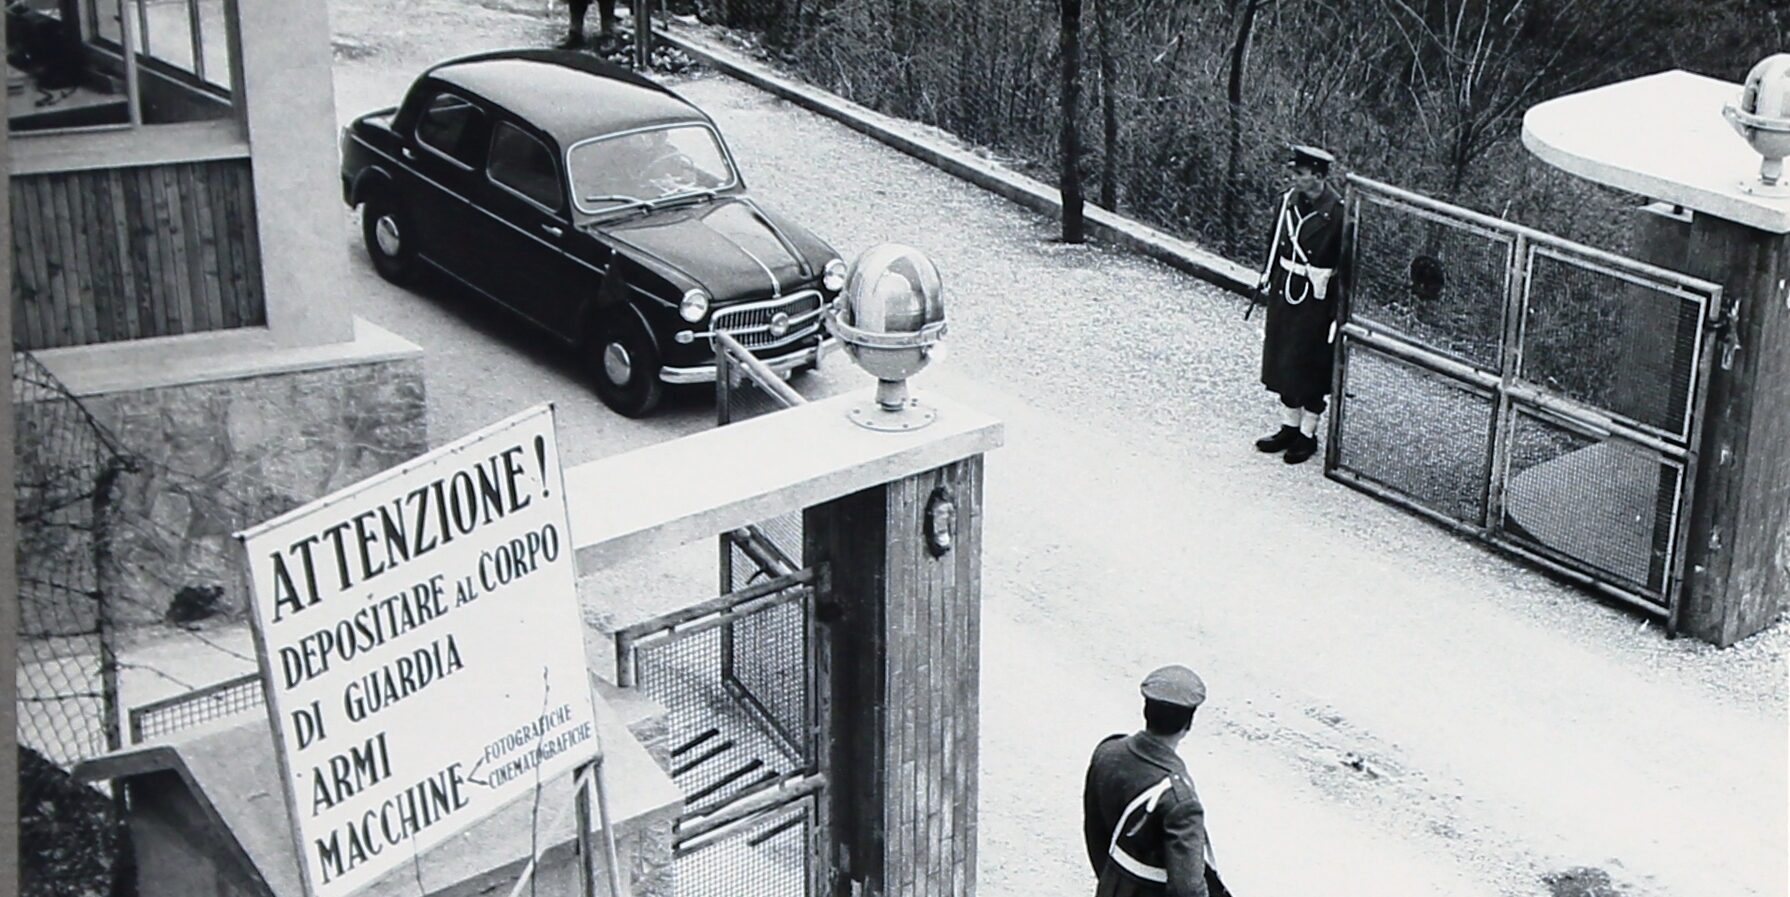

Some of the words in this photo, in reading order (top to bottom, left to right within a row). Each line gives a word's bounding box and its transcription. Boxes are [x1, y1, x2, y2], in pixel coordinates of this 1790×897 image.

[279, 574, 448, 690] DEPOSITARE
[455, 576, 478, 608] AL
[478, 524, 559, 592] CORPO
[291, 700, 327, 751] DI
[344, 634, 464, 722] GUARDIA
[484, 704, 572, 763] FOTOGRAFICHE
[312, 731, 392, 817] ARMI
[489, 721, 591, 789] CINEMATOGRAFICHE
[315, 762, 469, 885] MACCHINE
